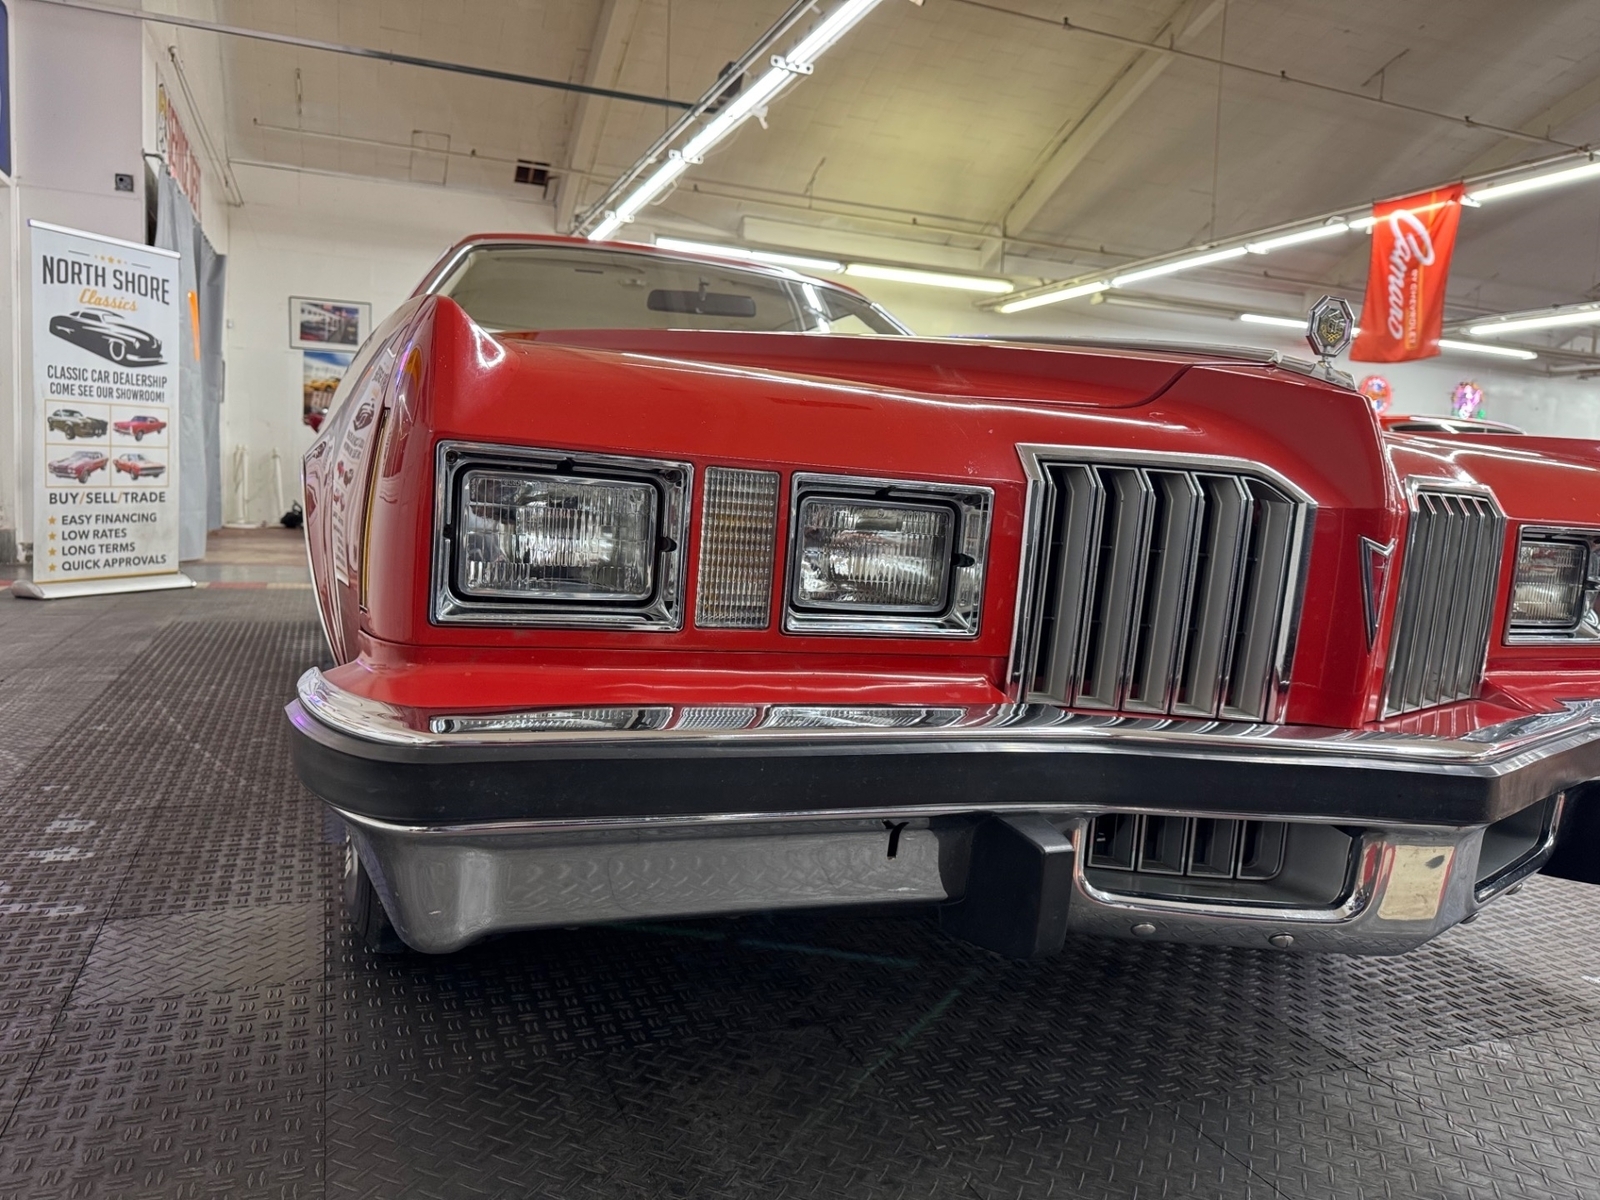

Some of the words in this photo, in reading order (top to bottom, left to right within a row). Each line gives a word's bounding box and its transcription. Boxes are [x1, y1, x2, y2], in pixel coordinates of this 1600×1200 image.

[42, 255, 106, 288] NORTH
[113, 269, 170, 306] SHORE
[1388, 209, 1435, 340] Camaro
[79, 288, 138, 312] Classics
[1409, 283, 1418, 344] CHEVROLET
[47, 364, 88, 382] CLASSIC
[91, 369, 110, 384] CAR
[113, 371, 168, 389] DEALERSHIP
[49, 382, 76, 396] COME
[78, 384, 94, 397] SEE
[96, 385, 114, 399] OUR
[115, 387, 165, 403] SHOWROOM!
[49, 491, 166, 505] BUY/SELL/TRADE
[61, 514, 92, 525] EASY
[95, 512, 157, 525] FINANCING
[61, 530, 90, 541] LOW
[93, 528, 127, 540] RATES
[61, 544, 96, 556] LONG
[98, 542, 136, 554] TERMS
[61, 559, 101, 571] QUICK
[103, 554, 167, 570] APPROVALS
